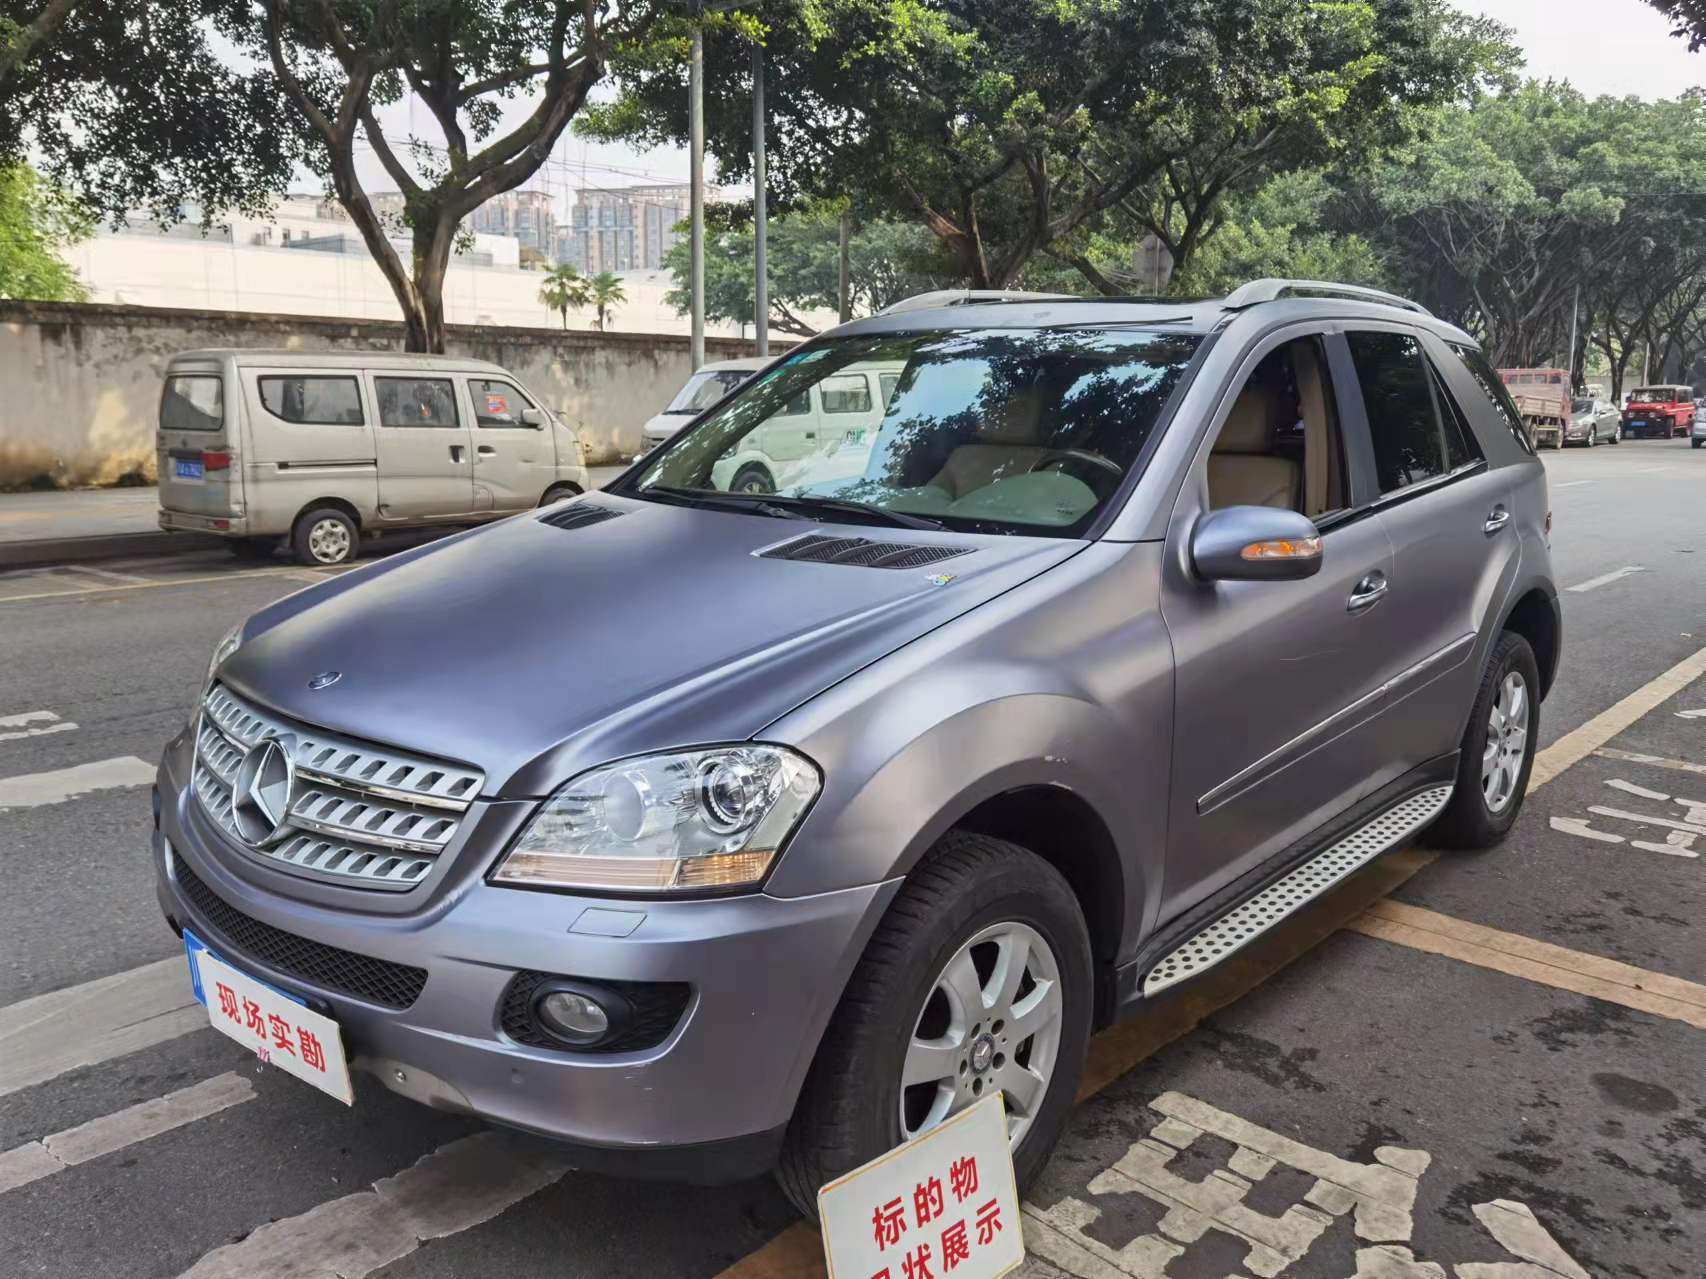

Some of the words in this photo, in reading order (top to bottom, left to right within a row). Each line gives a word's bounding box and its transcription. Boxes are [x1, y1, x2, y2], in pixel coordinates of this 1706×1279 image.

[216, 981, 326, 1073] 现场实勘
[871, 1198, 1003, 1279] 状展示
[872, 1156, 979, 1251] 标的物
